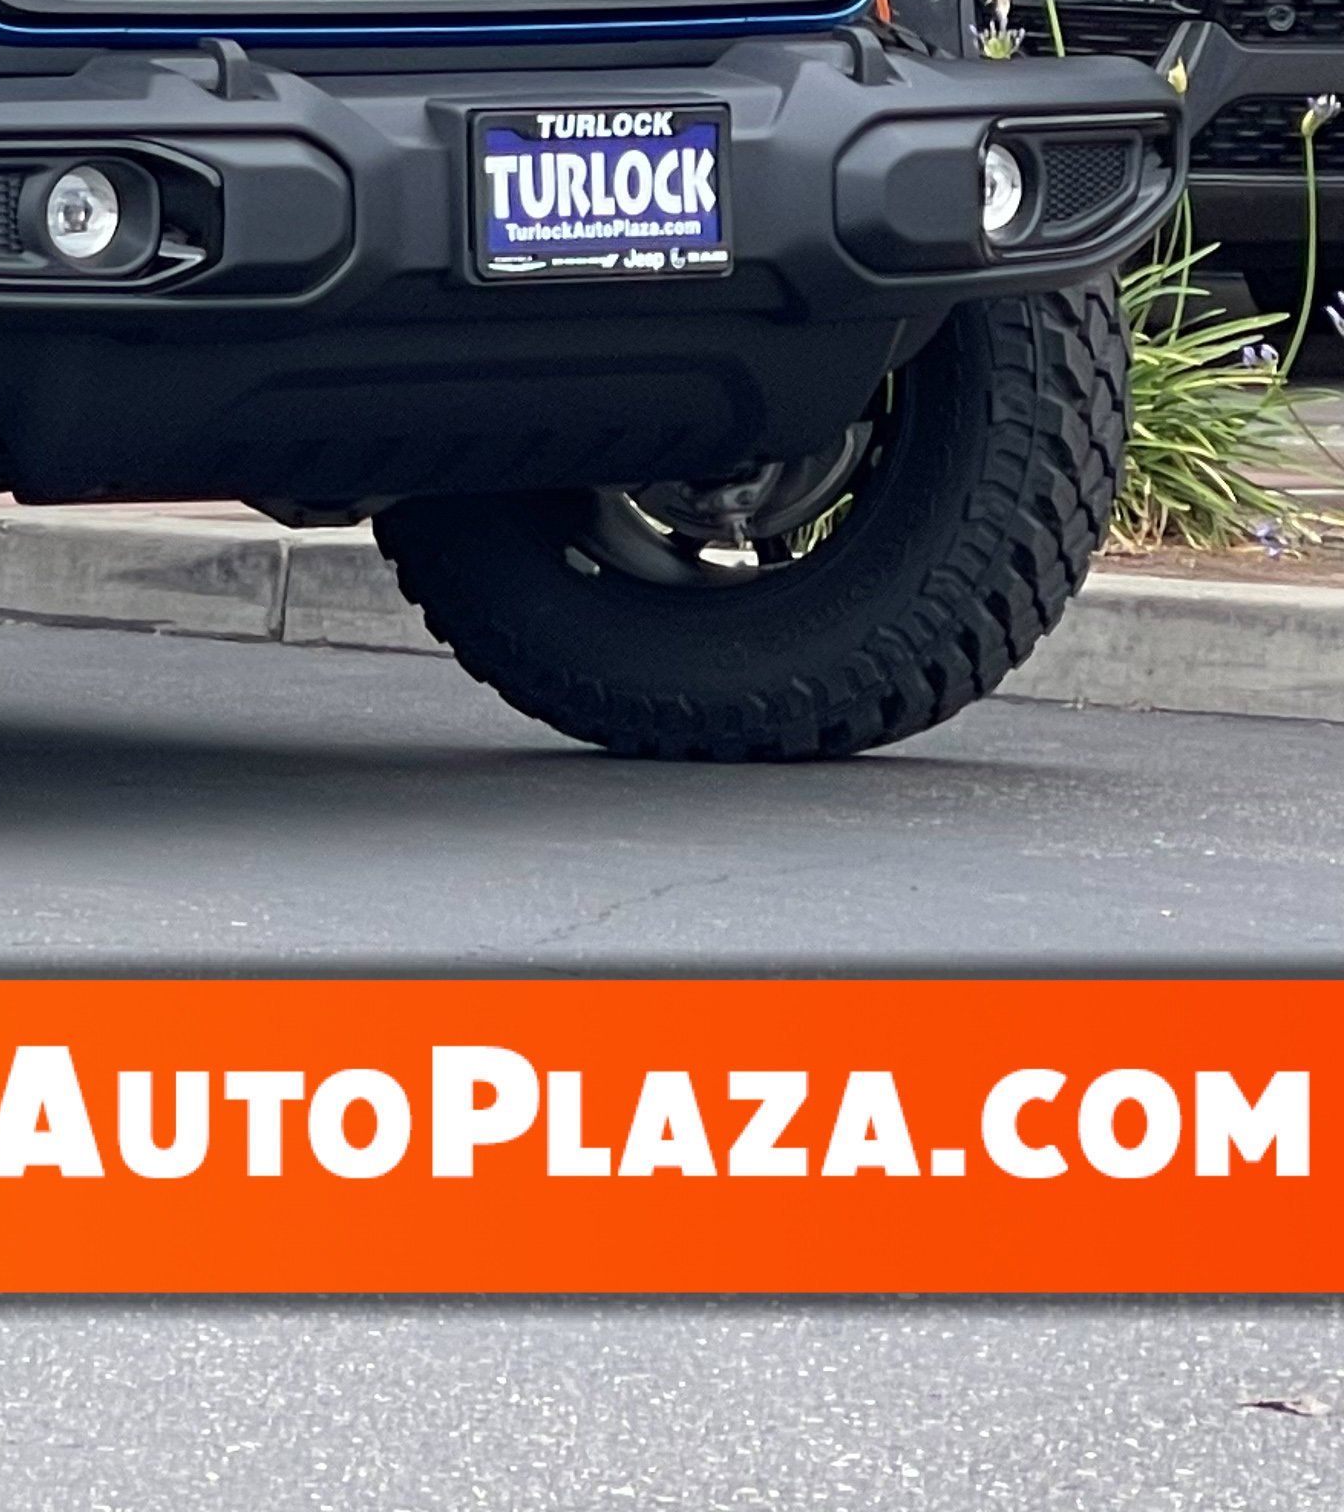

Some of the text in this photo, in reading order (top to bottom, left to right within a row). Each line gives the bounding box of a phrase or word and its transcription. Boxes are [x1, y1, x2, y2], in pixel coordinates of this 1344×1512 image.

[537, 111, 674, 139] TURLOCK
[484, 147, 717, 220] TURLOCK
[505, 219, 702, 243] TurlockAutoPlaza.com
[623, 248, 666, 272] Jeep
